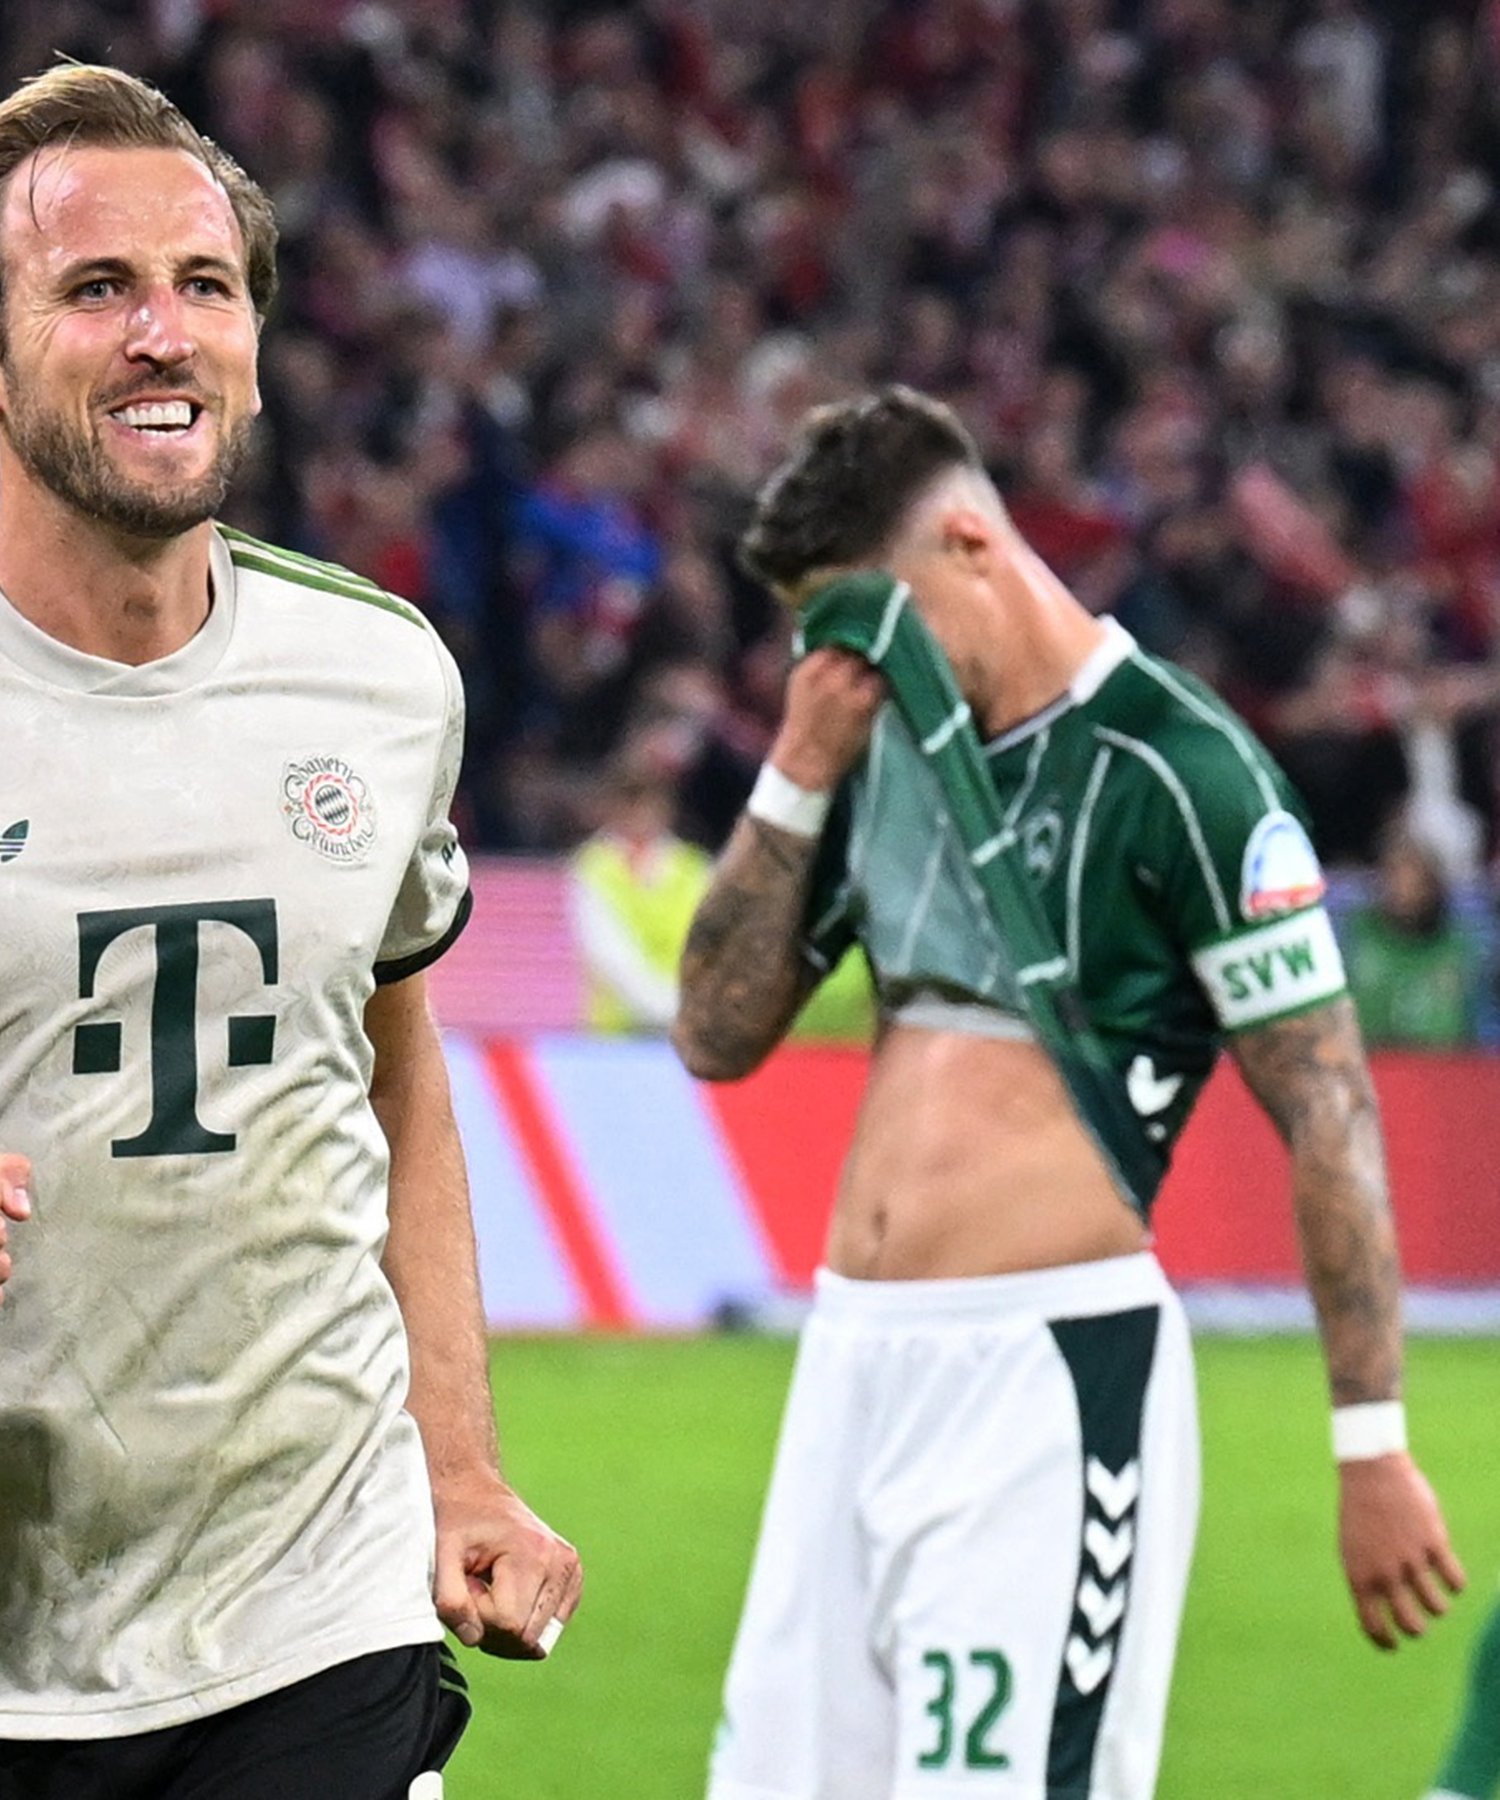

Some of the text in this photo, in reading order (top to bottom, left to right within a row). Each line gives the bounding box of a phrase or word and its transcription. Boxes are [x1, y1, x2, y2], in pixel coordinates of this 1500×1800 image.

[73, 897, 279, 1158] T
[1221, 937, 1316, 1000] SVW
[917, 1649, 1012, 1769] 32
